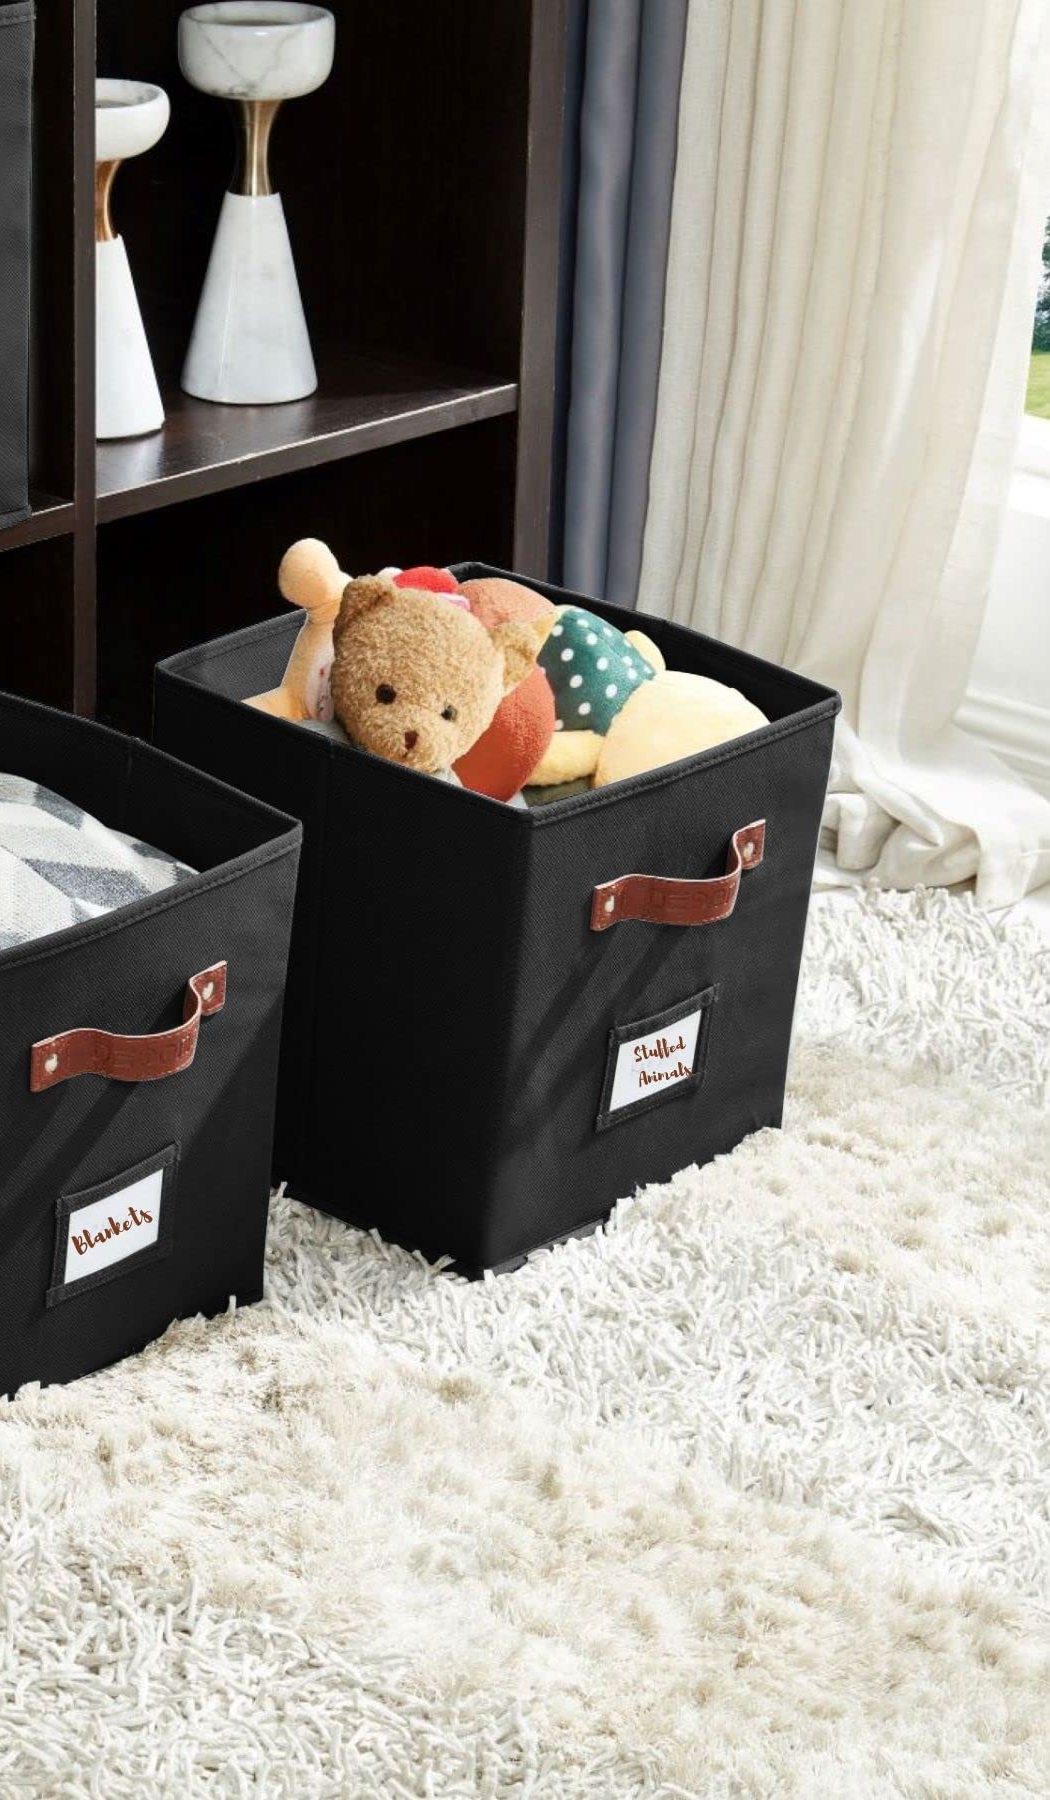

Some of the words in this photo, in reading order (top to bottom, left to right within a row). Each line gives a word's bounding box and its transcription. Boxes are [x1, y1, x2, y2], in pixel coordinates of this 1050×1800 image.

[633, 1036, 686, 1062] Stuffed
[639, 1062, 695, 1087] Animals
[71, 1207, 153, 1255] Blankets
